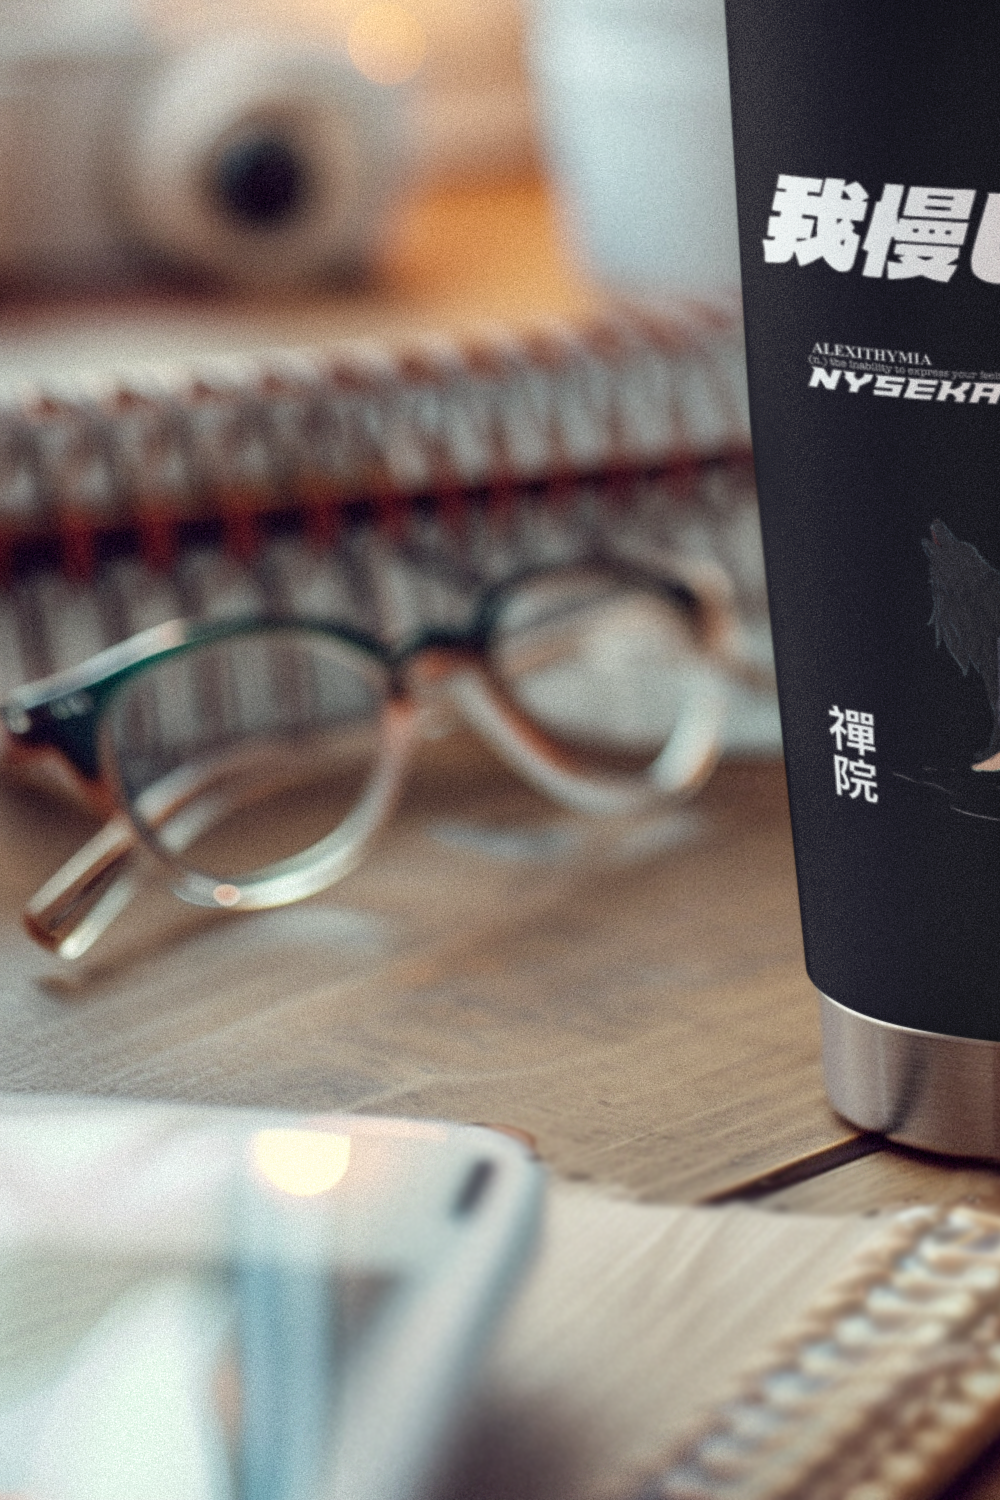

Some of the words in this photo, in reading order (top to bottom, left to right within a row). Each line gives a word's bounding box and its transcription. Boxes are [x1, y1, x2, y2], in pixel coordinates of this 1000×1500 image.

[811, 341, 933, 366] ALEXITHYMIA
[849, 359, 892, 374] inability
[894, 365, 905, 375] to
[907, 367, 949, 379] express
[951, 370, 978, 380] your
[828, 704, 879, 804] 禪院
